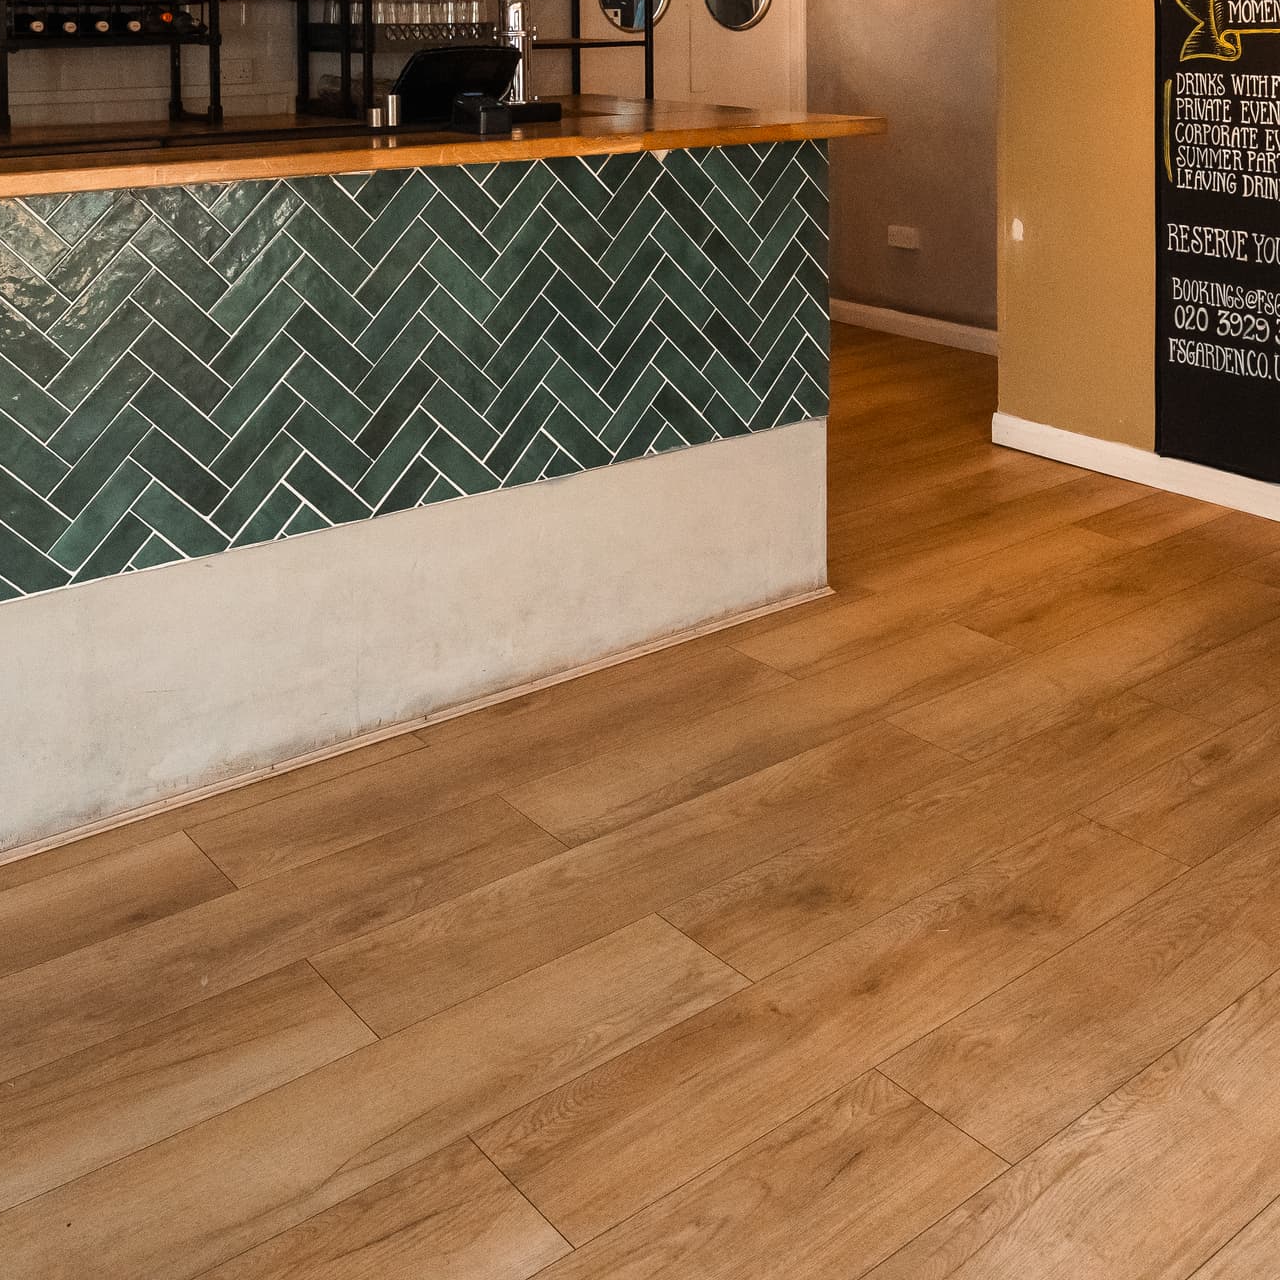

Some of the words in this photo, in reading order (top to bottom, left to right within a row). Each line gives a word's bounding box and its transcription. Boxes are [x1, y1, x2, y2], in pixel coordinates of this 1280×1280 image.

[1176, 72, 1226, 98] DRINKS
[1231, 74, 1269, 99] WITH
[1175, 98, 1233, 122] PRIVATE
[1174, 122, 1260, 150] CORPORATE
[1175, 146, 1243, 171] SUMMER
[1176, 168, 1238, 194] LEAVING
[1167, 223, 1249, 262] RESERVE
[1174, 305, 1209, 332] 020
[1215, 309, 1271, 343] 3929
